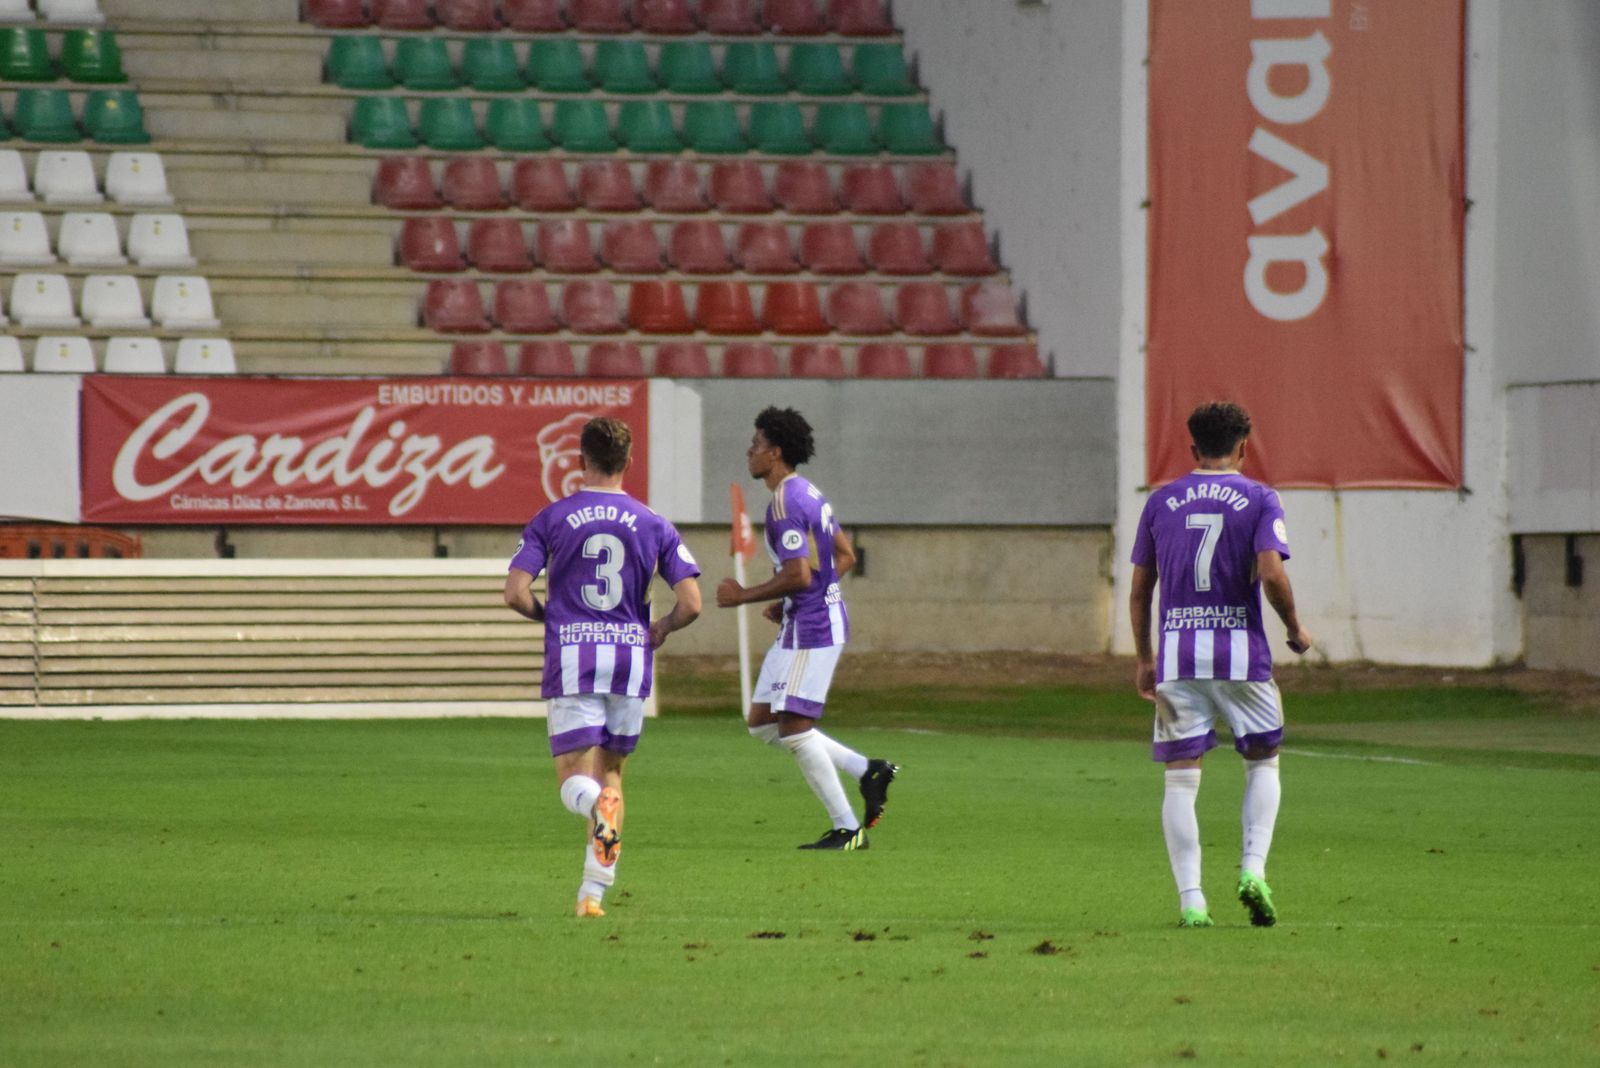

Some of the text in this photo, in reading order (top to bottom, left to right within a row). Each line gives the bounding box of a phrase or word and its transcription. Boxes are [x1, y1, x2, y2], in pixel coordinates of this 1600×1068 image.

[378, 385, 632, 406] EMBUTIDOS Y JAMONES
[112, 393, 505, 516] Cardiza
[264, 495, 281, 510] de
[284, 495, 339, 512] Zamora,
[341, 496, 368, 510] S.L.
[566, 505, 637, 532] DIEGO M.
[1186, 513, 1224, 592] 7
[581, 533, 625, 611] 3
[1166, 605, 1246, 619] HERBALIFE
[559, 622, 645, 635] HERBALIFE
[1164, 617, 1247, 630] NUTRITION
[559, 631, 645, 646] NUTRITION
